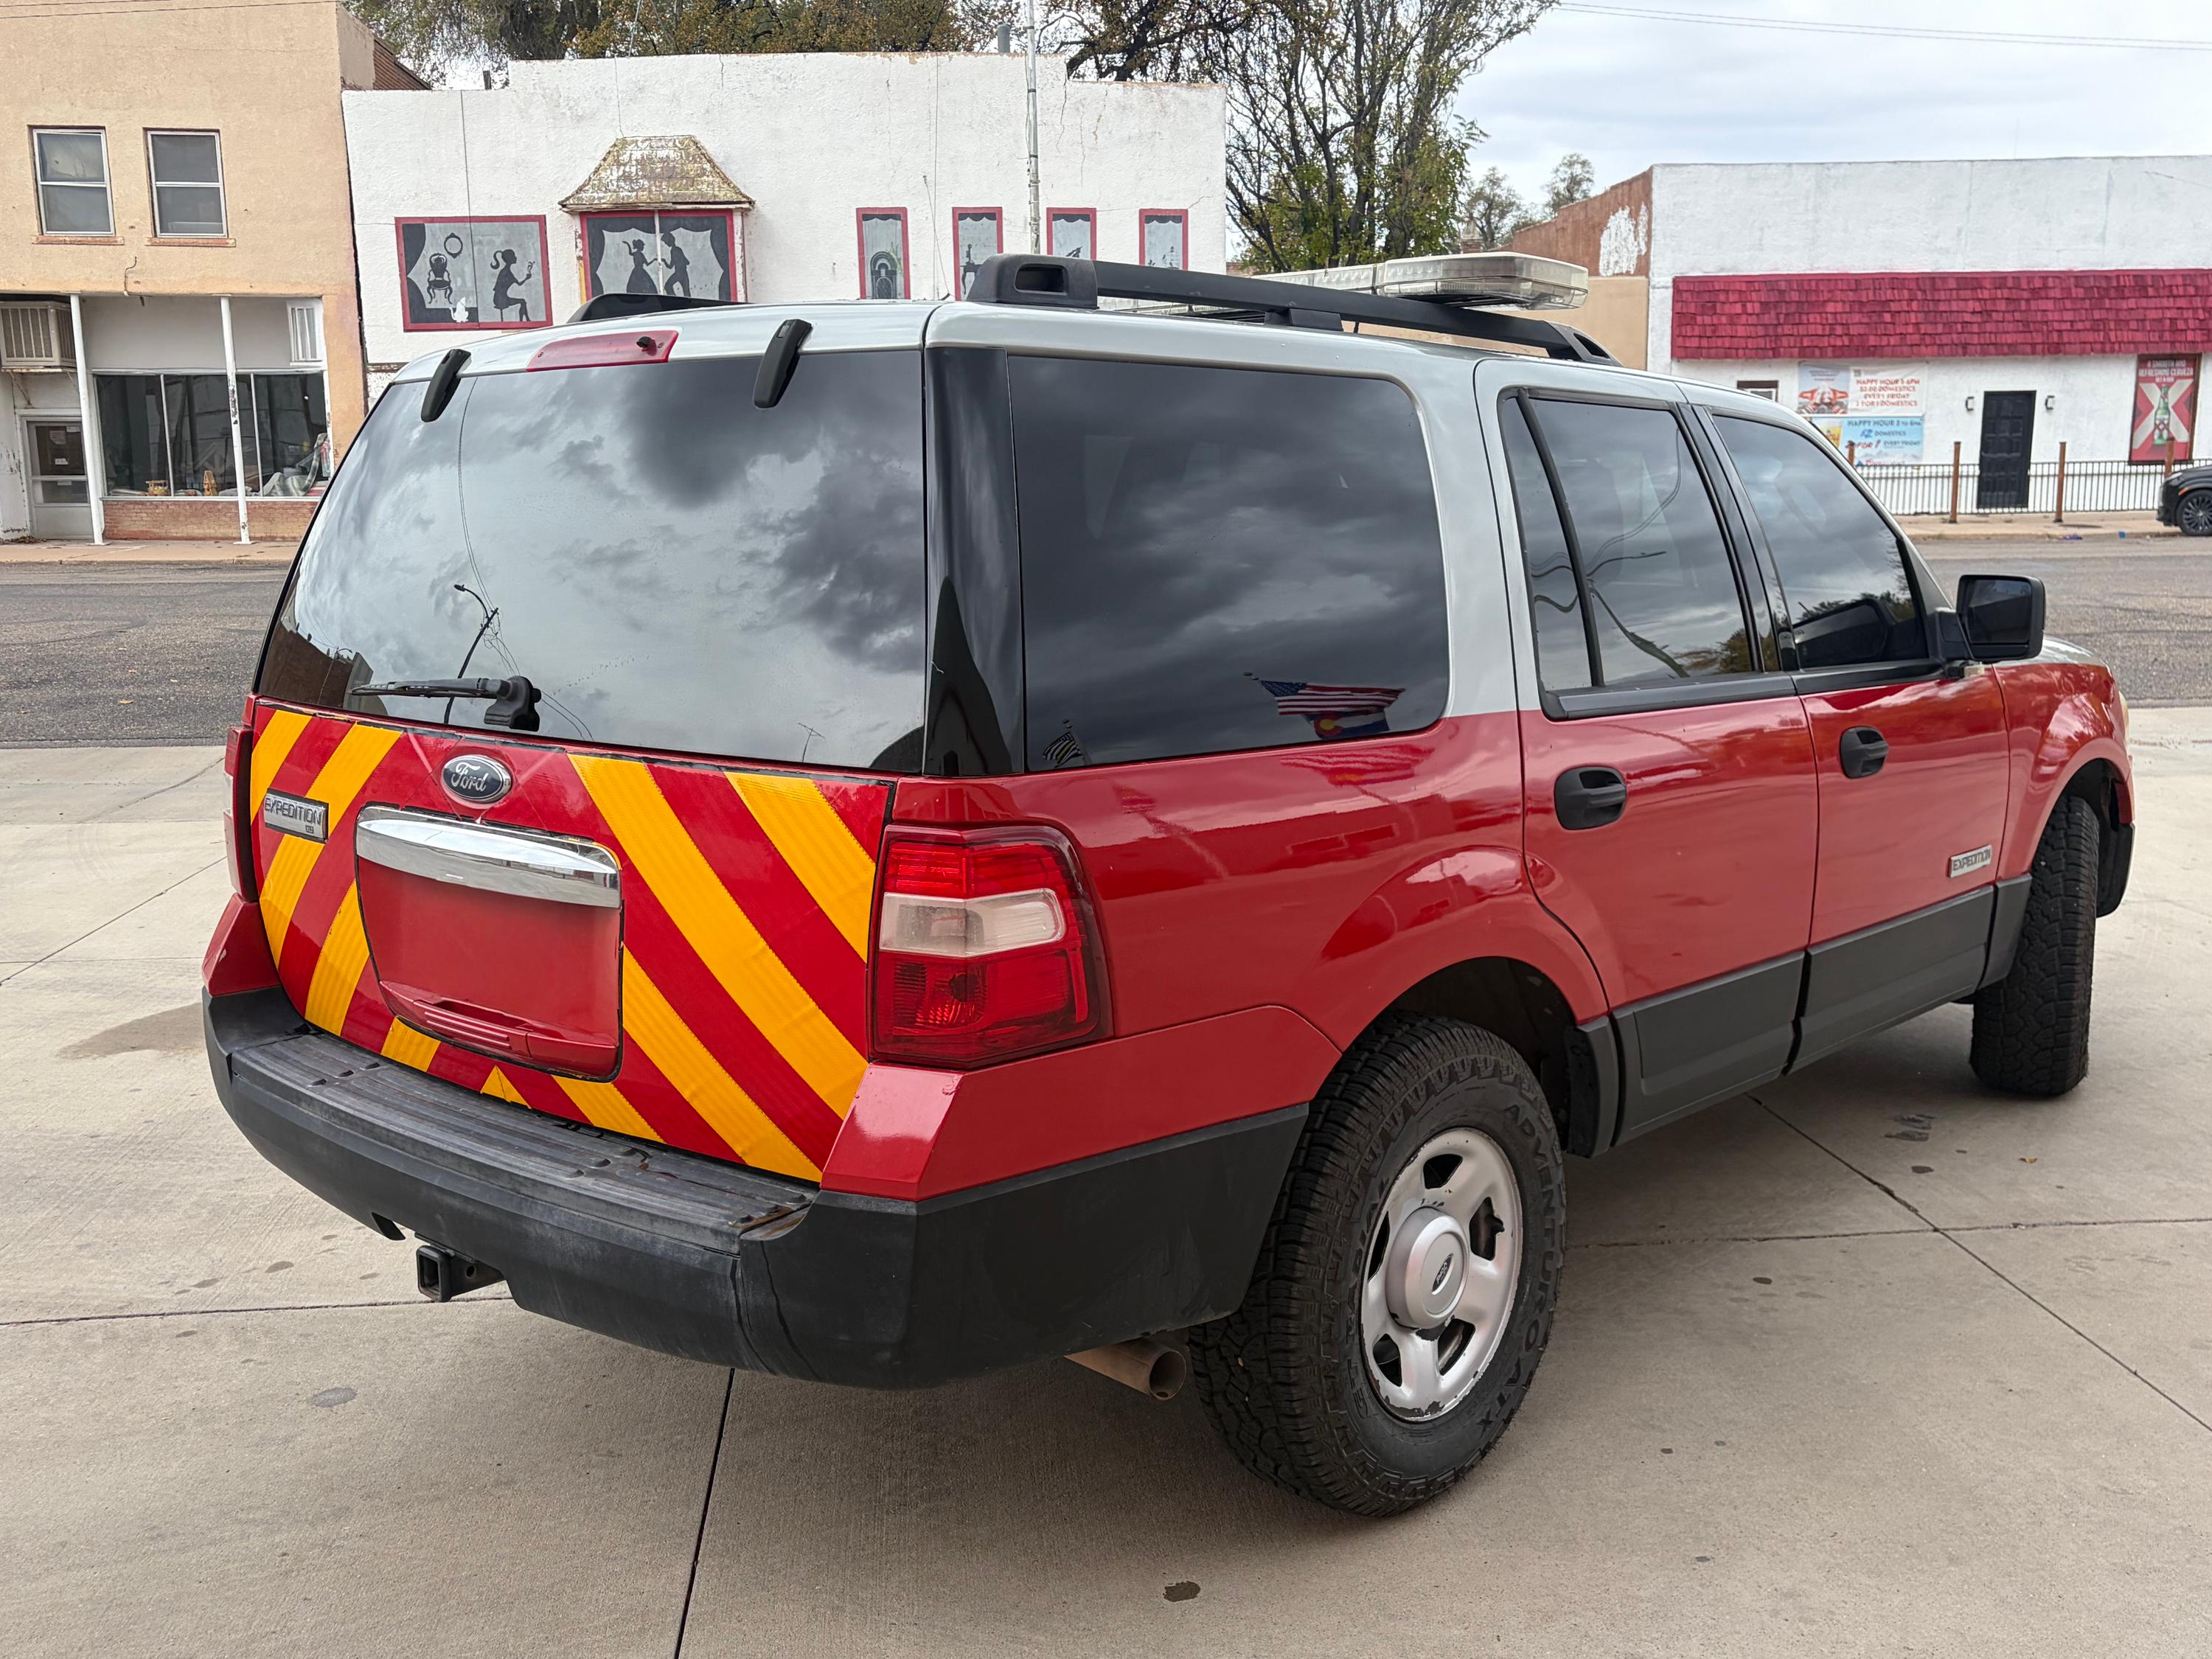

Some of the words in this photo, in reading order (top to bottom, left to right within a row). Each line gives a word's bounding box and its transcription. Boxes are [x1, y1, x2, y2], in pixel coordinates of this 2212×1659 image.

[451, 761, 489, 792] Ford
[265, 797, 323, 826] EXPEDITION
[1952, 847, 1991, 871] EXPEDITION
[1504, 1104, 1556, 1353] ADVENTURO
